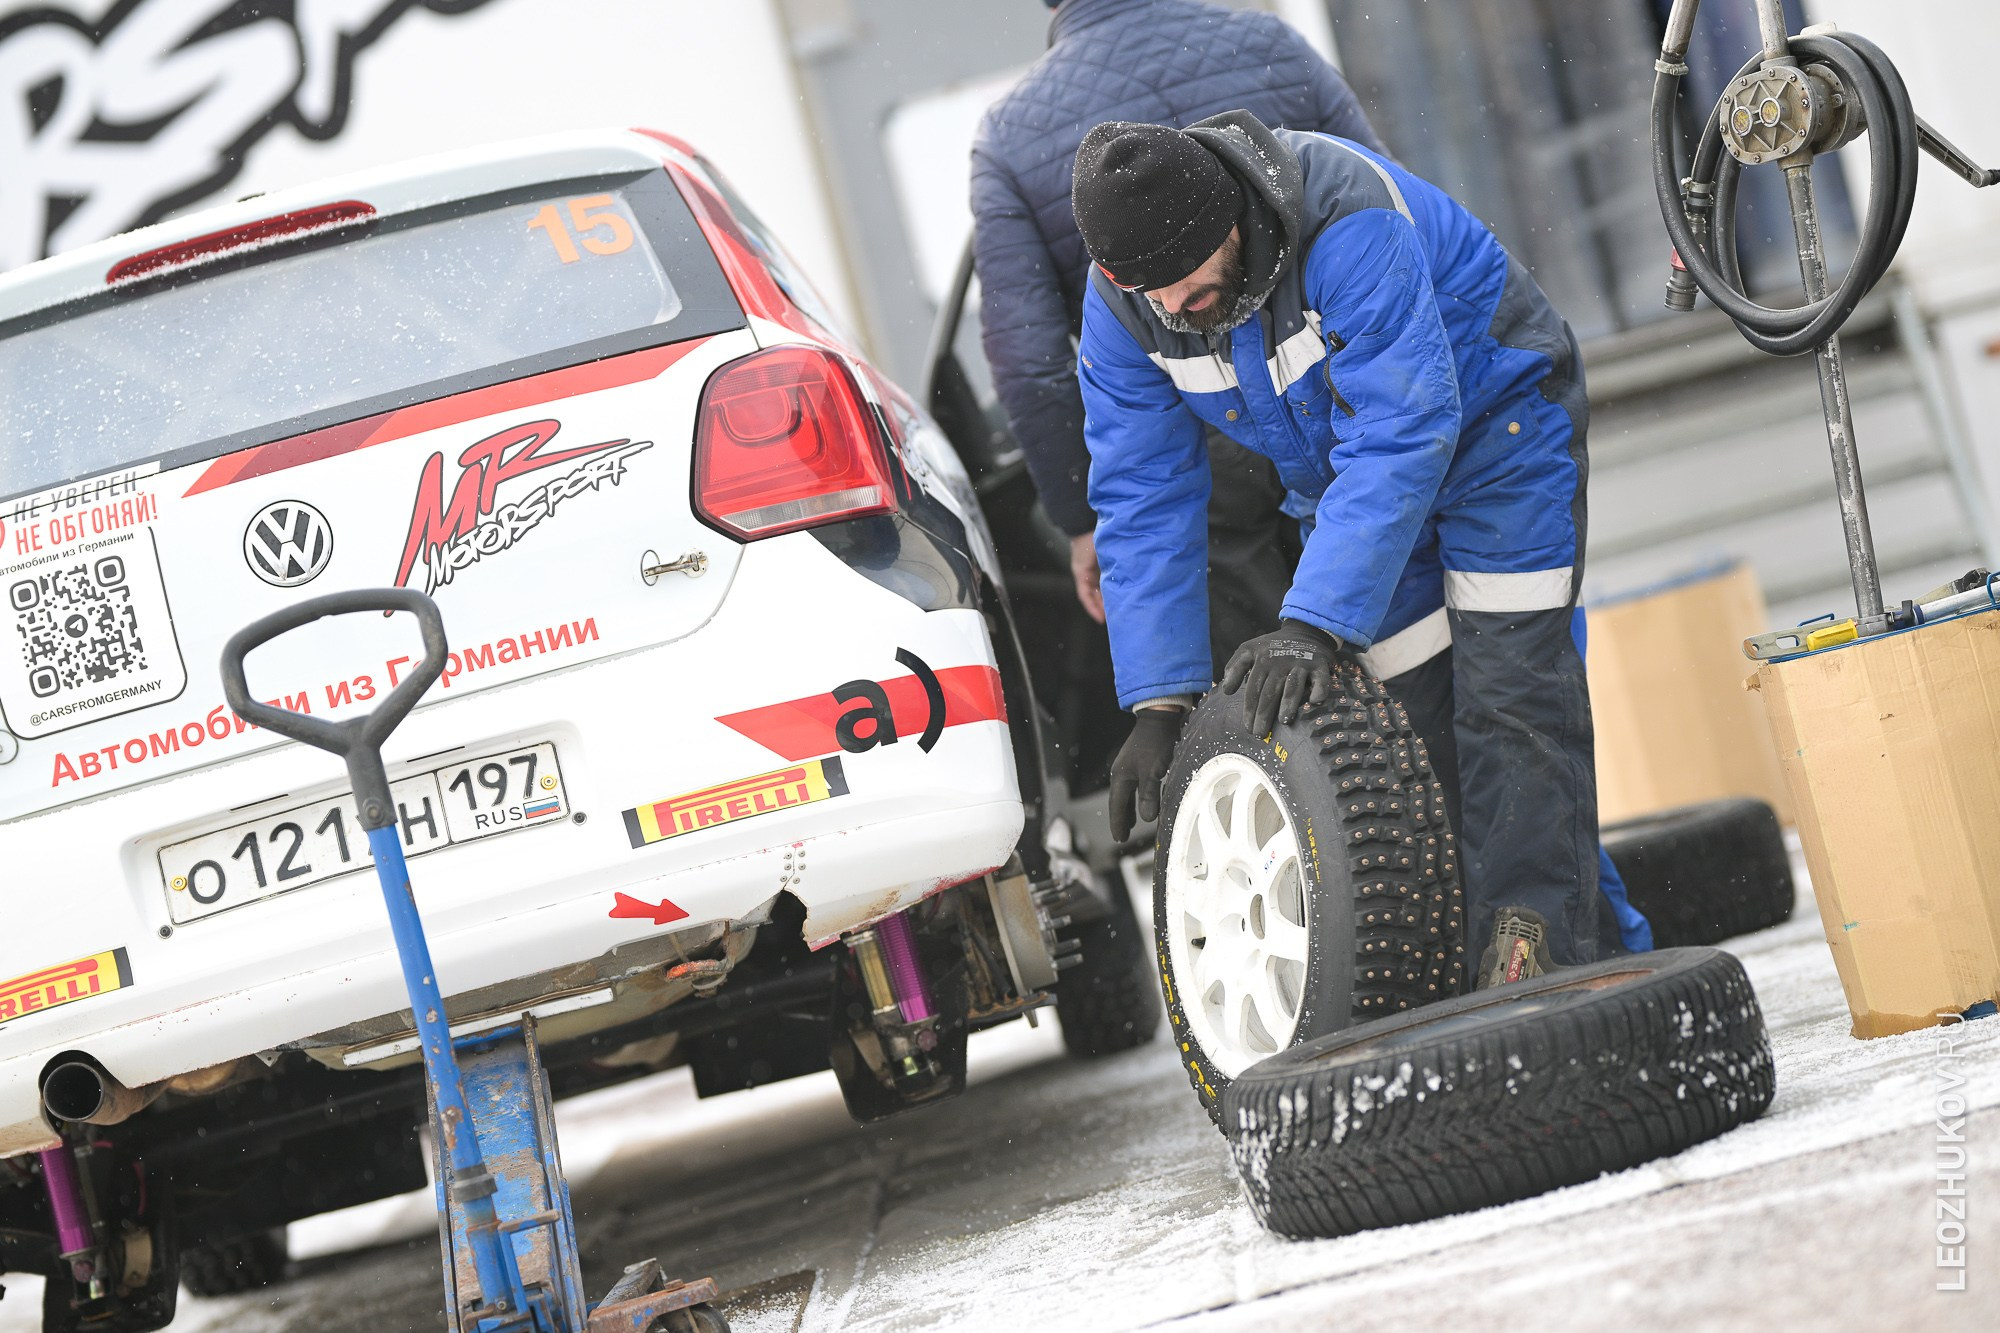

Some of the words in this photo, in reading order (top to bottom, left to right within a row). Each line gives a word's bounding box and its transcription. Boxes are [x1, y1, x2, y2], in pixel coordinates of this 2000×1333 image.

[527, 194, 634, 264] 15
[13, 496, 41, 524] НЕ
[50, 470, 138, 513] УВЕРЕН
[15, 523, 43, 555] НЕ
[49, 491, 158, 545] ОБГОНЯЙ!
[62, 547, 76, 558] из
[78, 532, 135, 553] Германии
[325, 675, 376, 709] из
[386, 617, 600, 688] Грмании
[29, 679, 163, 727] @CARSFROMGERMANY
[449, 752, 538, 811] 197
[652, 767, 812, 837] PIRELLI
[474, 806, 523, 829] RUS
